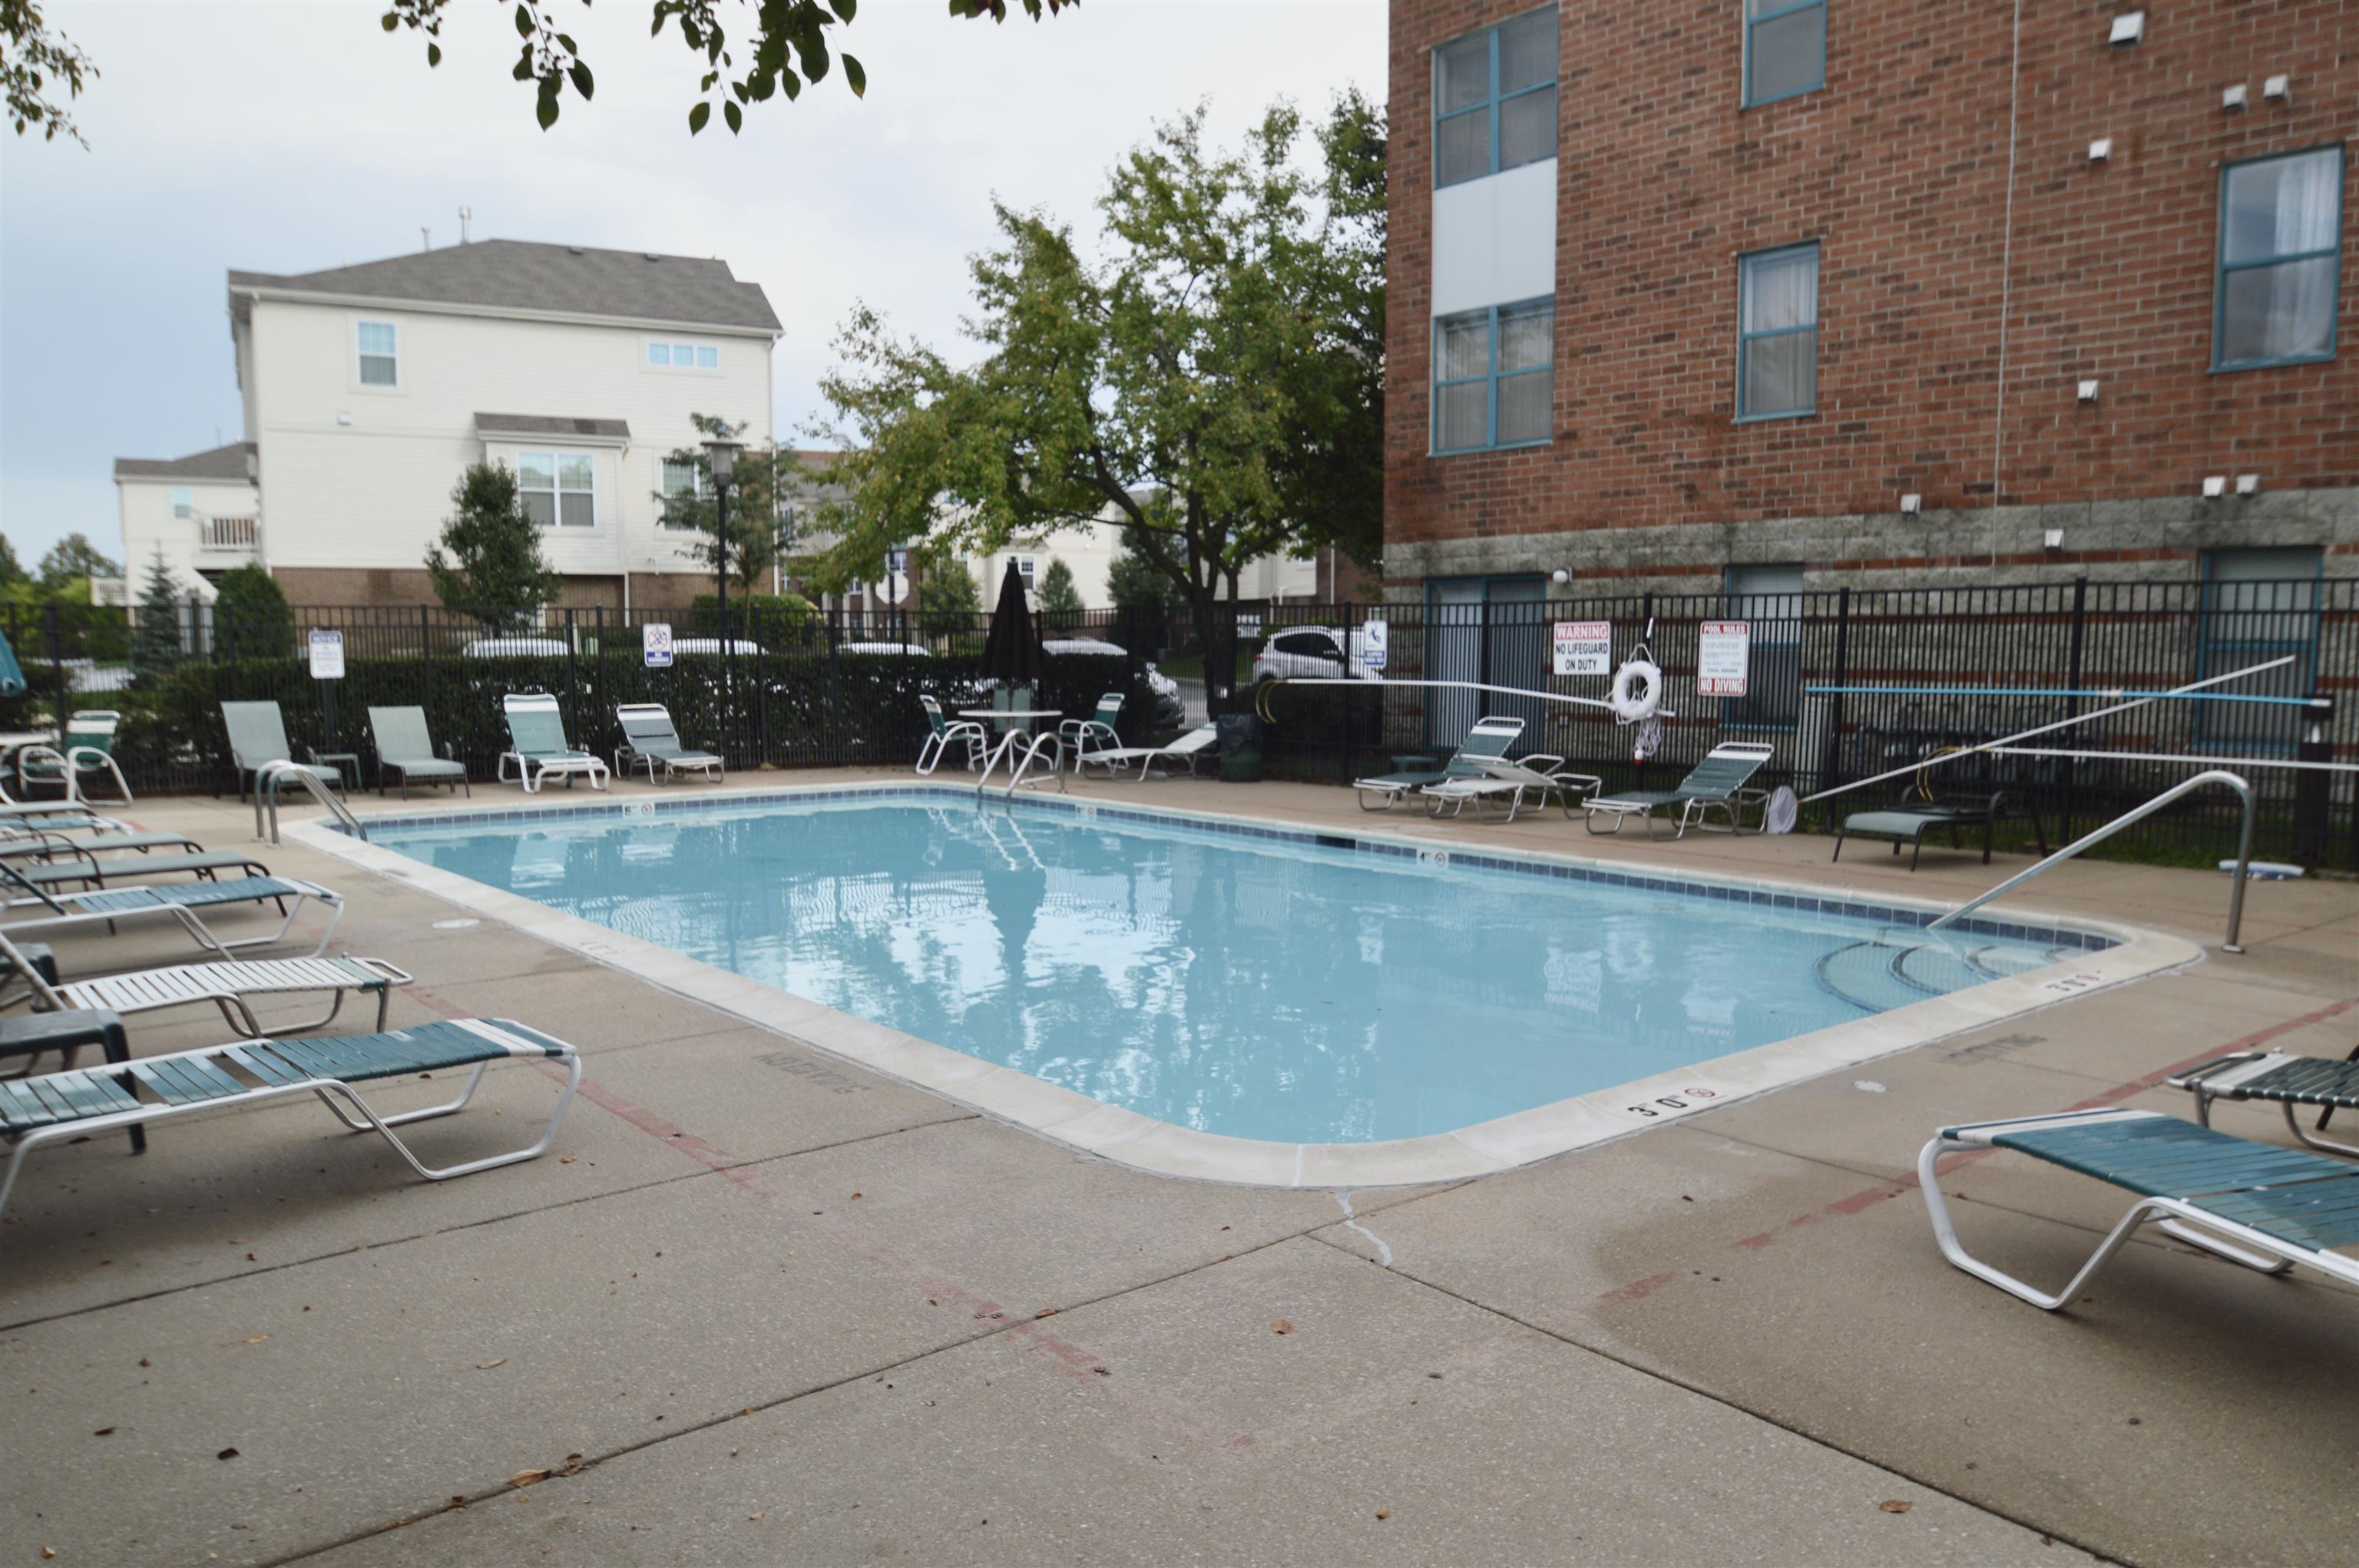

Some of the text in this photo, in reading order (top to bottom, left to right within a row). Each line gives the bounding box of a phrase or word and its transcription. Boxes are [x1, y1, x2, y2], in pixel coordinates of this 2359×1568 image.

[1556, 626, 1608, 640] WARNING
[1704, 624, 1745, 633] POOL RULES
[1556, 643, 1608, 654] NO LIFEGUARD
[1565, 659, 1597, 670] ON DUTY
[1700, 678, 1743, 693] NO DIVING
[1627, 1107, 1659, 1116] 3
[1656, 1098, 1689, 1109] 0
